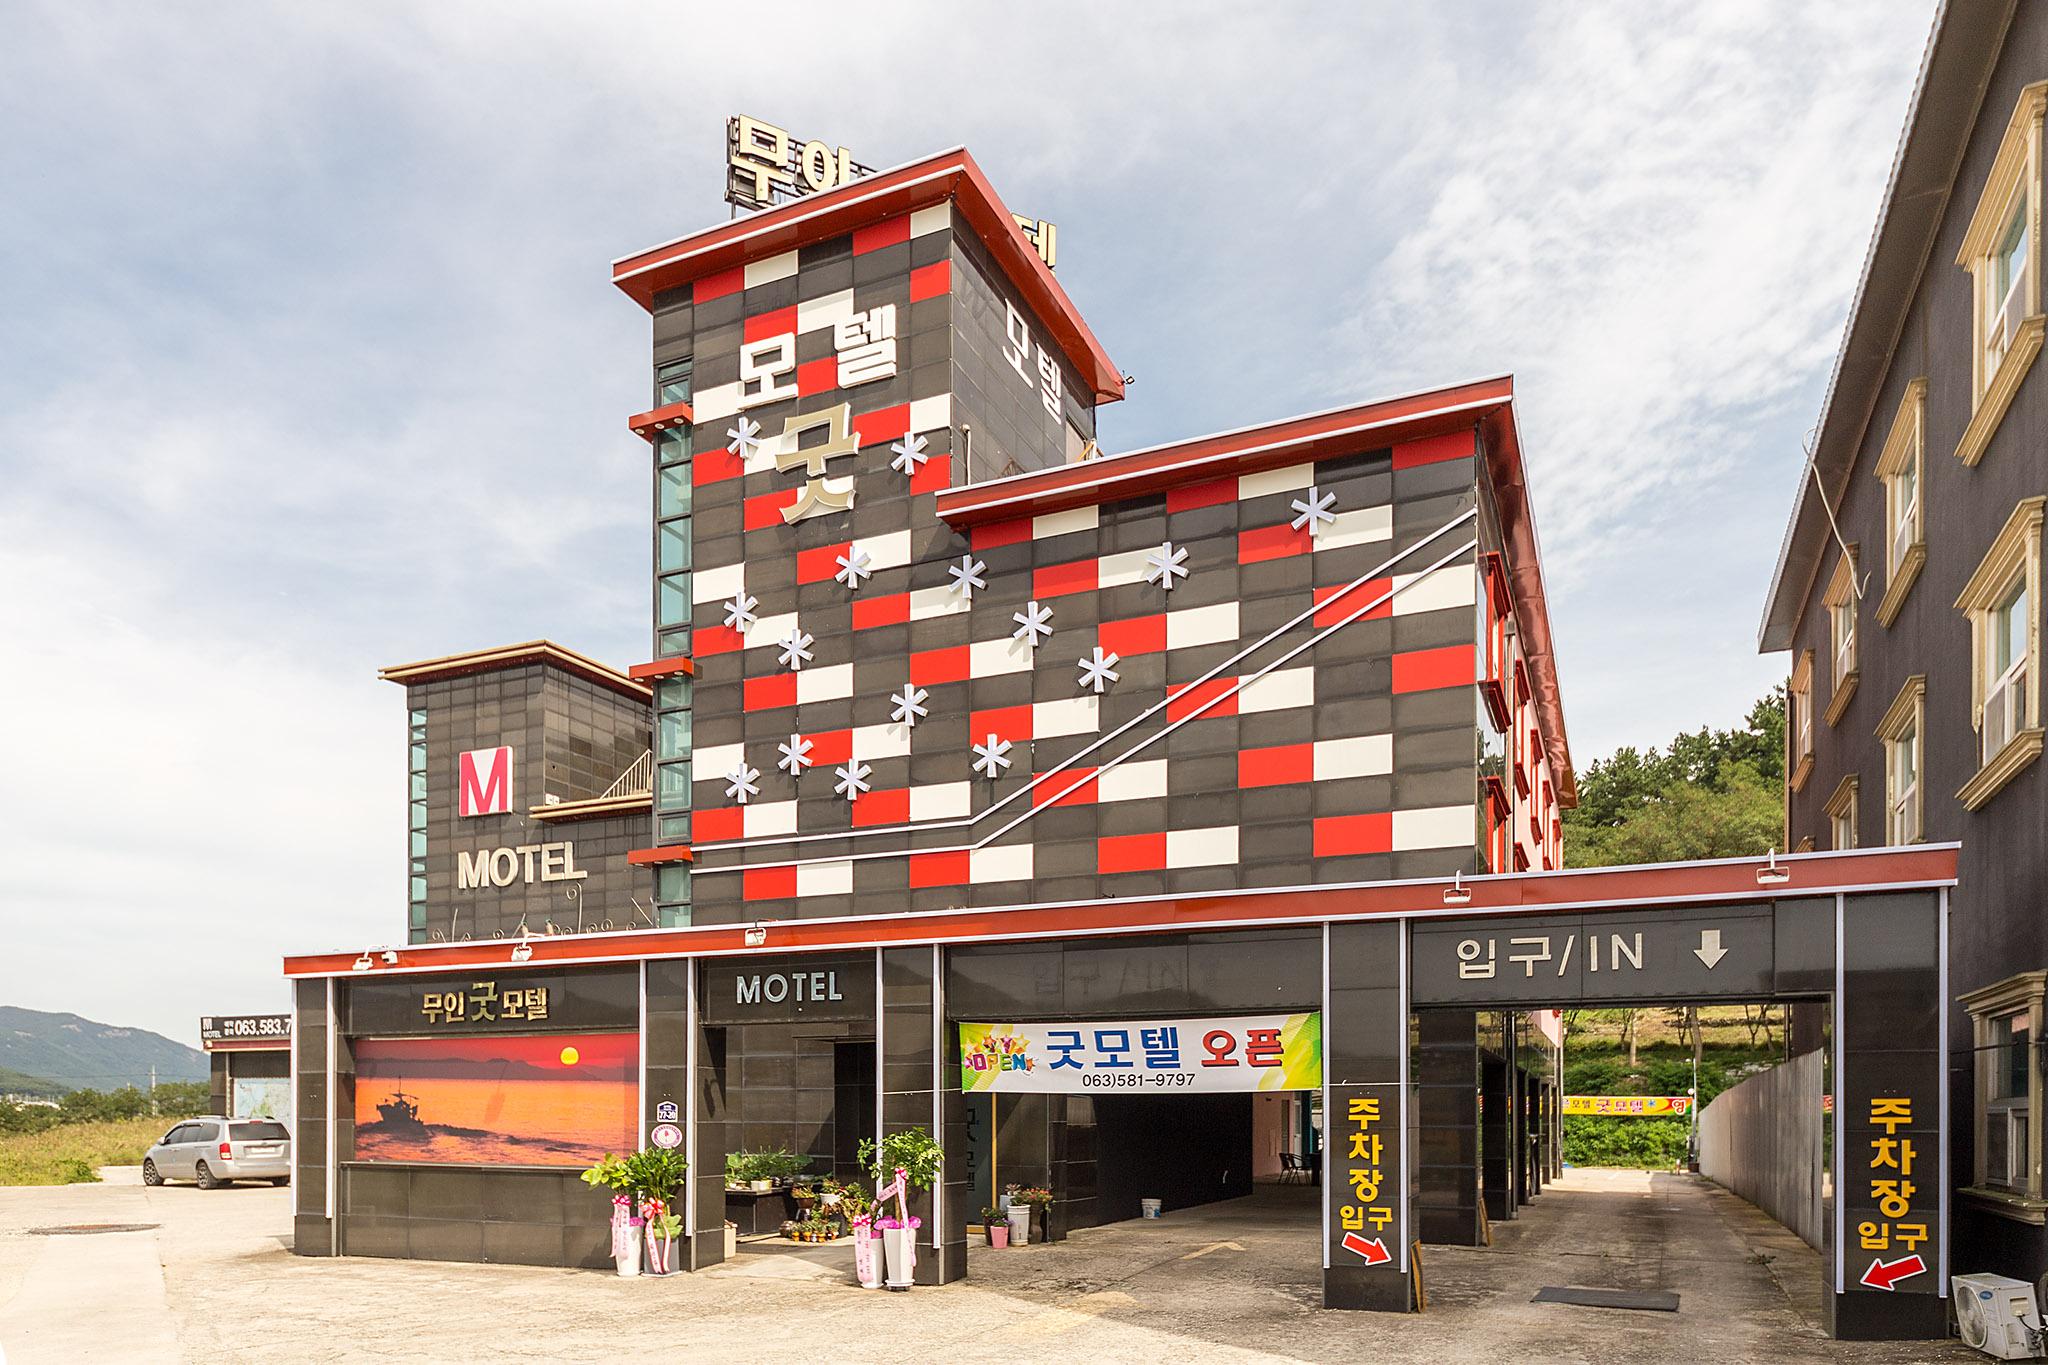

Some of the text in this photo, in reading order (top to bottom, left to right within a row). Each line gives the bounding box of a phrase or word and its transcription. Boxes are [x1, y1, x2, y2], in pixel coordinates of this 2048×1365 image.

[737, 304, 896, 409] 모텔
[1003, 297, 1062, 424] 모텔
[775, 402, 860, 525] 굿
[459, 746, 510, 816] M
[458, 841, 587, 889] MOTEL
[421, 982, 549, 1023] 무인 굿 모텔
[736, 971, 843, 1004] MOTEL
[973, 1053, 1028, 1072] OPEN
[1046, 1026, 1284, 1070] 굿모텔 오픈
[1082, 1073, 1195, 1089] 063)581-9797
[1348, 1097, 1383, 1204] 주차장
[1869, 1097, 1917, 1220] 주차장
[1339, 1205, 1393, 1231] 입구
[1857, 1221, 1929, 1250] 입구
